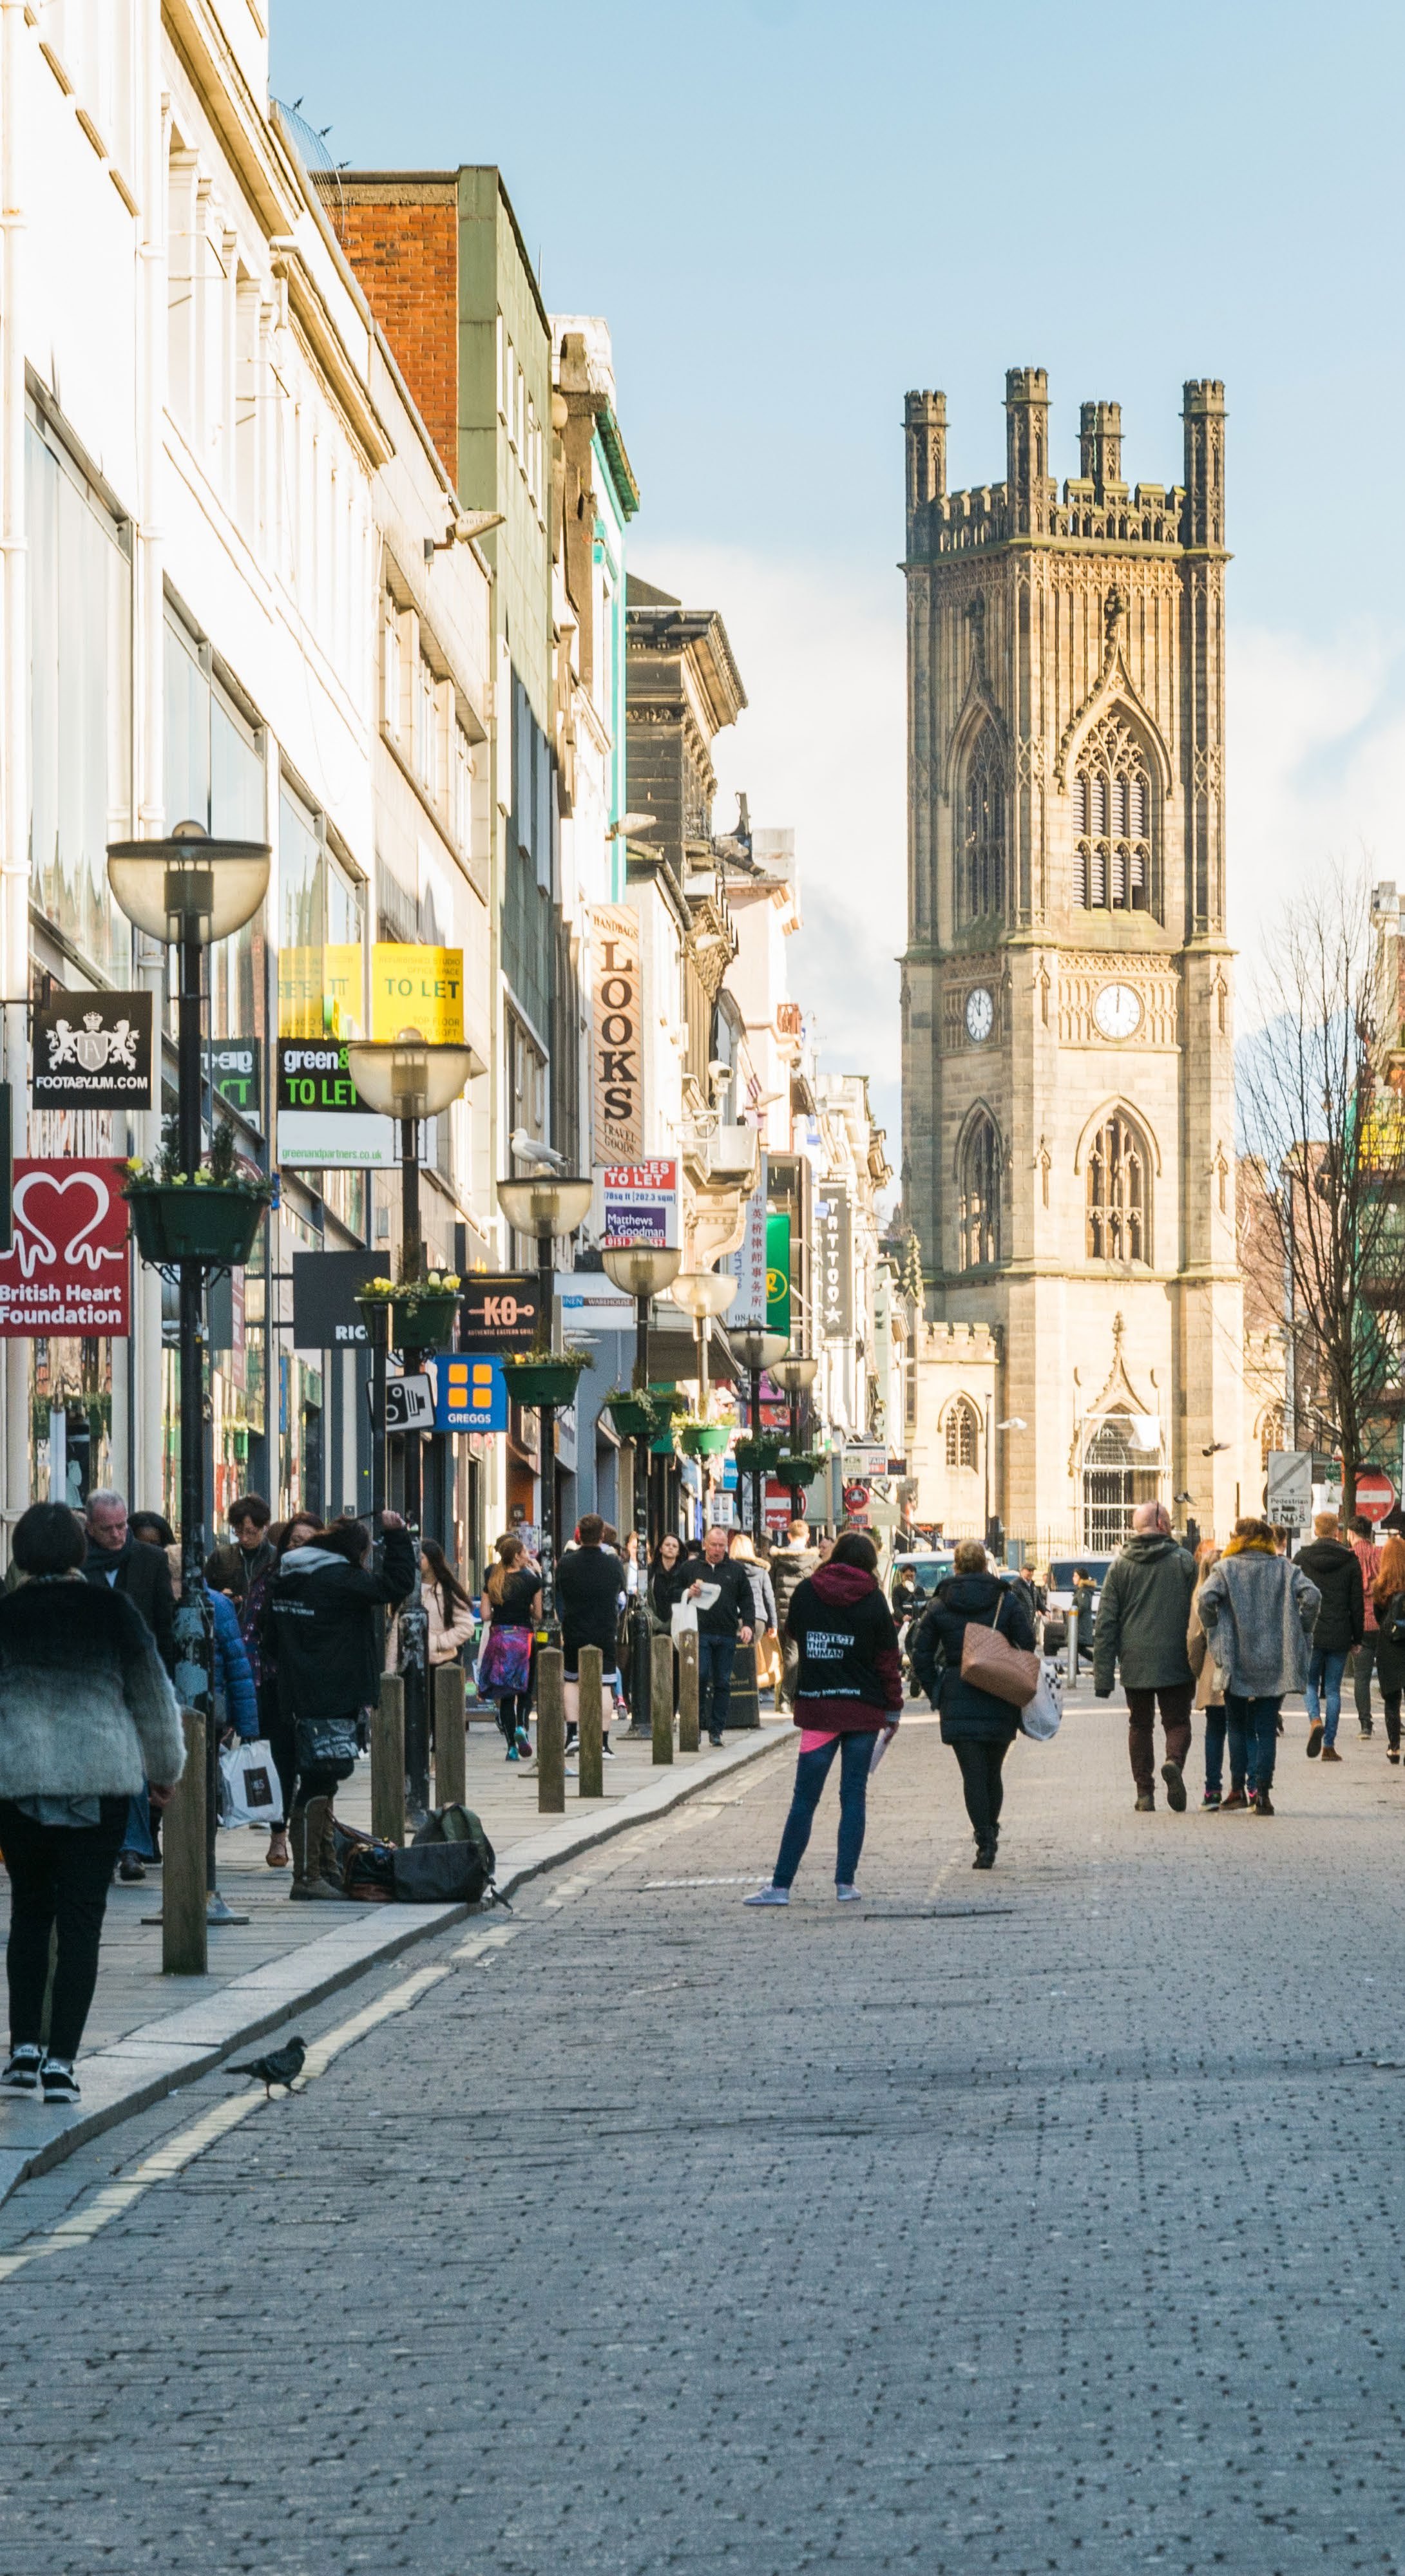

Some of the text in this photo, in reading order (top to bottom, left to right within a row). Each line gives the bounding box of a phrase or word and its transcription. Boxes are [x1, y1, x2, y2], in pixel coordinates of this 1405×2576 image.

[593, 914, 638, 938] HANDBAGS
[385, 978, 459, 999] TO LET
[599, 941, 637, 1120] LOOKS
[285, 1078, 316, 1104] TO
[604, 1122, 636, 1144] TRAVEL
[604, 1135, 635, 1155] GOODS
[282, 1148, 382, 1160] greenandpartners.co.uk
[607, 1172, 664, 1187] TO LET
[607, 1213, 653, 1226] Matthews
[618, 1225, 665, 1237] Goodman
[827, 1198, 839, 1303] TATTOO
[0, 1283, 121, 1302] British Heart
[0, 1303, 121, 1324] Foundation
[336, 1325, 368, 1340] RIC
[447, 1413, 492, 1425] GREGGS
[1272, 1513, 1306, 1522] ENDS
[807, 1632, 854, 1645] PROTECT
[807, 1649, 843, 1658] HUMAN
